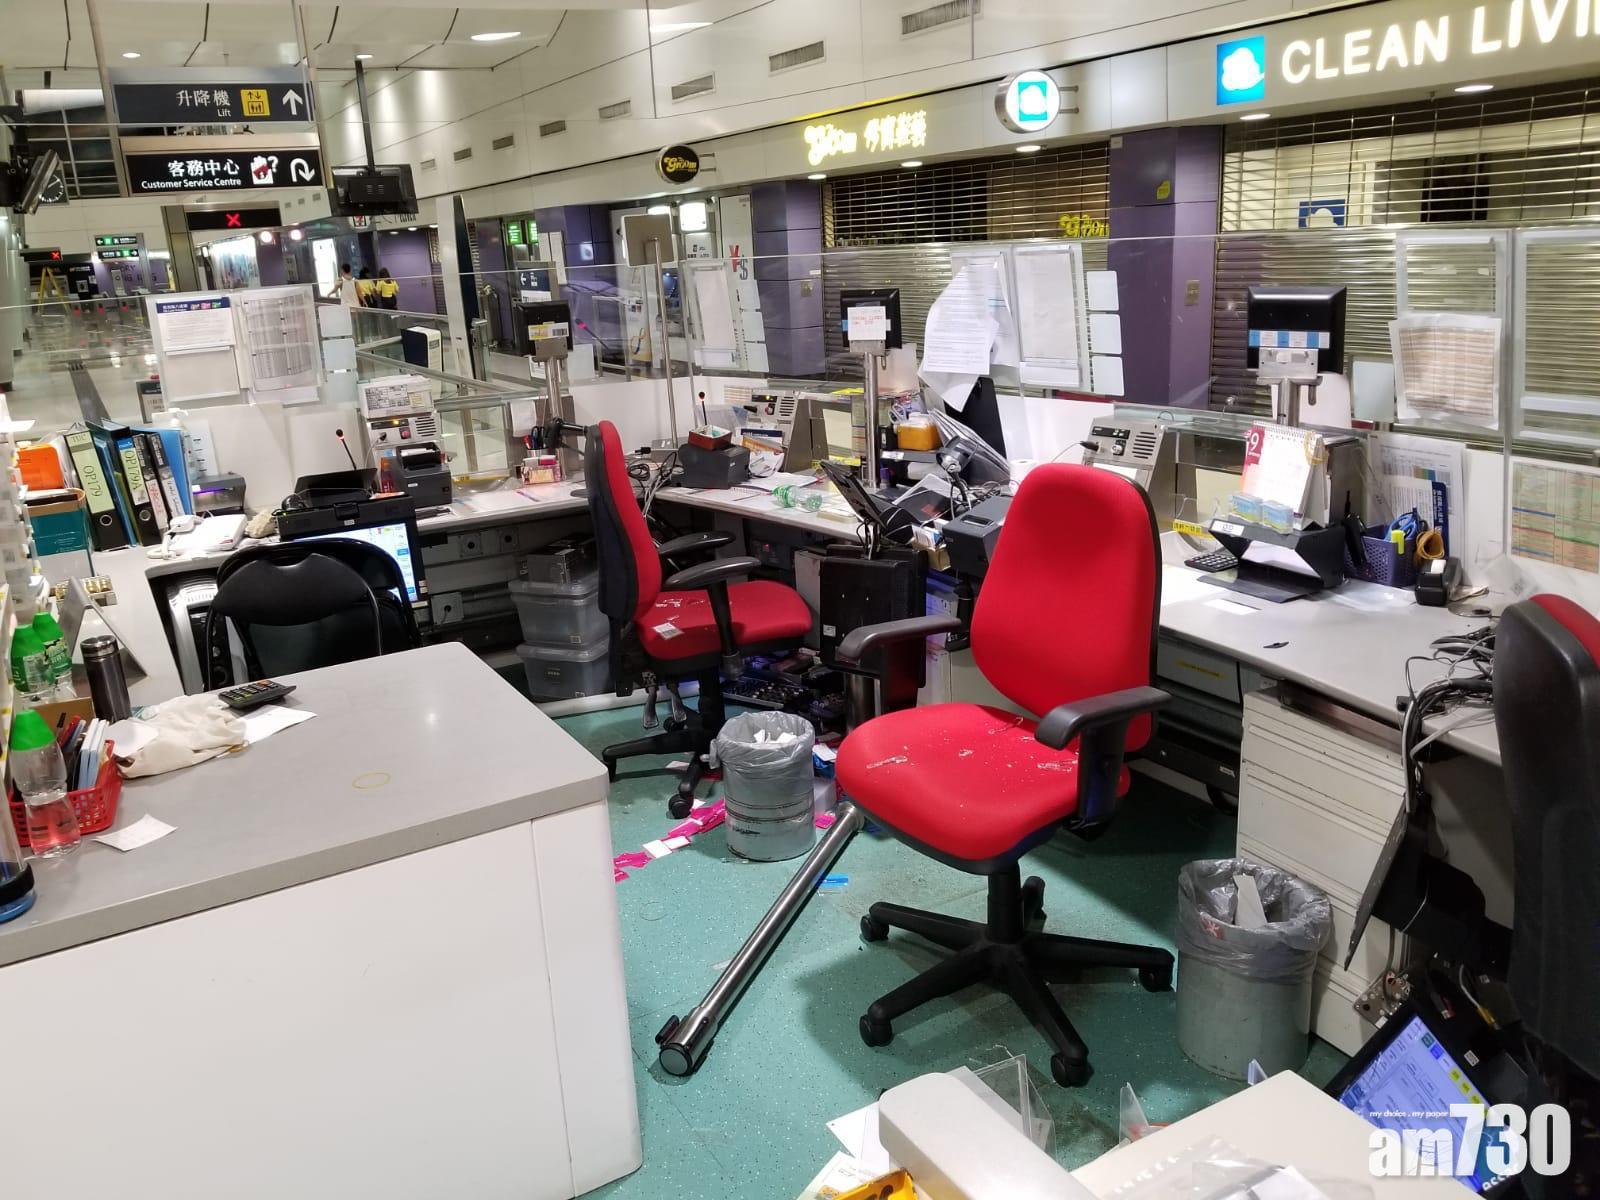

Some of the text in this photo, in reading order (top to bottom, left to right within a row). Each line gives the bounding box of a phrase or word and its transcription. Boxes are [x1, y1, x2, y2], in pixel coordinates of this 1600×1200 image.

[1281, 0, 1600, 85] CLEAN LIVI
[175, 89, 231, 106] 升降機
[217, 108, 231, 117] Lift
[167, 158, 240, 178] 客務中心
[141, 177, 242, 189] Customer Service Centre
[1250, 432, 1260, 451] 9
[83, 465, 103, 497] OP179
